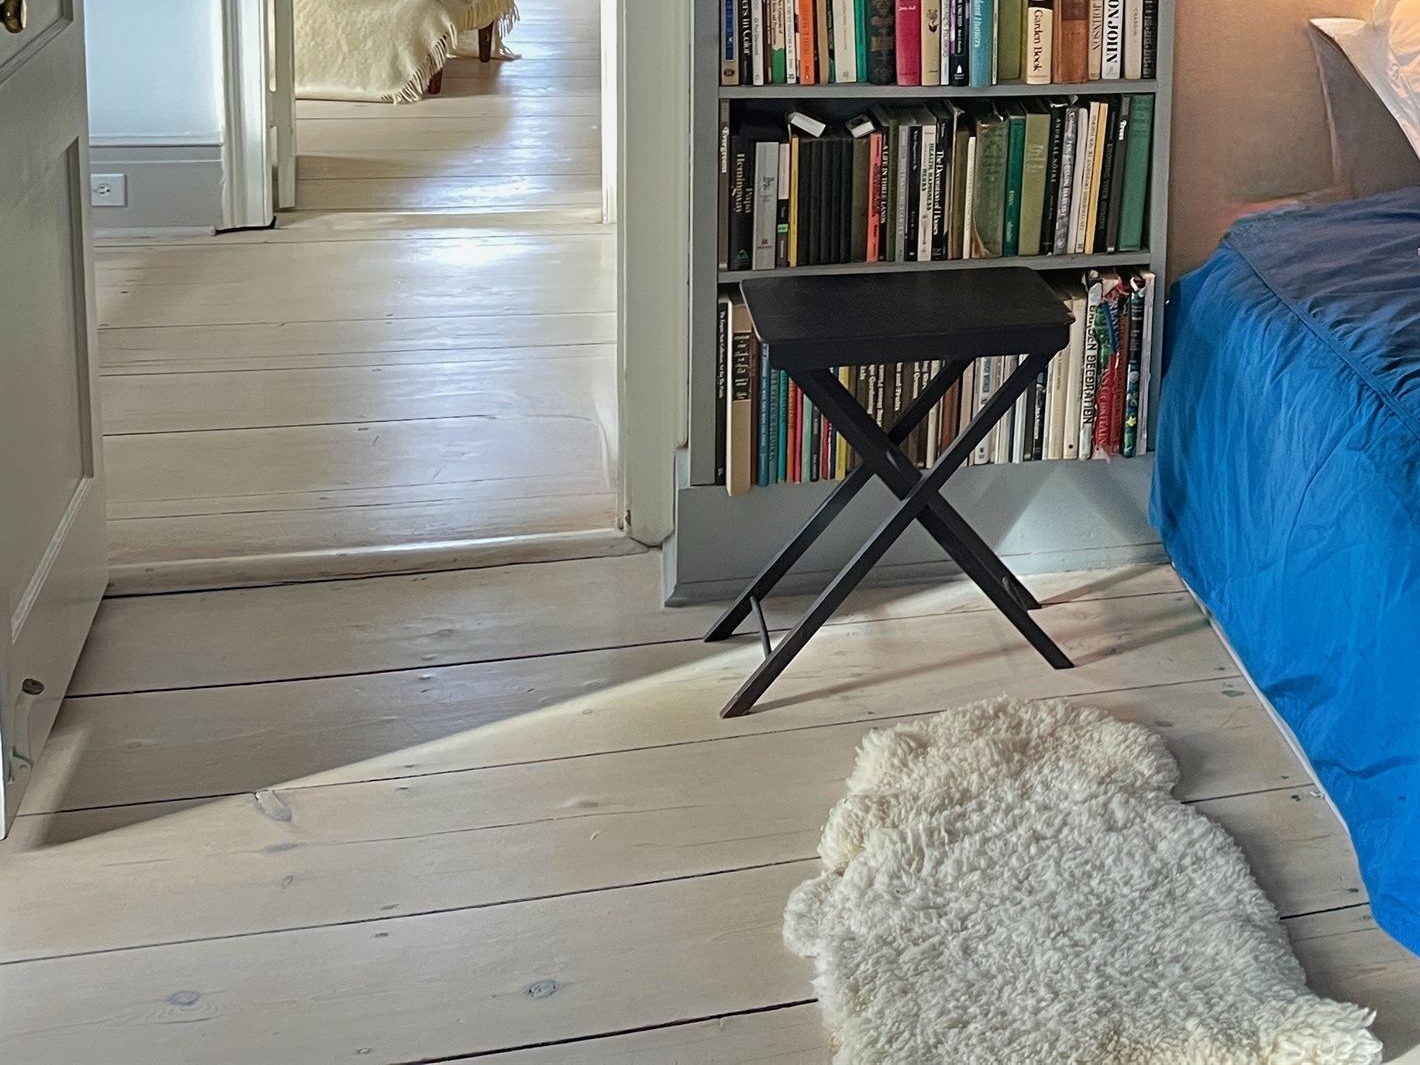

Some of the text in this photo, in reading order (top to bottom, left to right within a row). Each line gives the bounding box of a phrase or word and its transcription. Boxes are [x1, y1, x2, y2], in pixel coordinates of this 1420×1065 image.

[742, 19, 751, 29] in
[742, 30, 752, 56] Color
[973, 17, 983, 48] Hunters
[1034, 10, 1044, 44] Garden
[1091, 4, 1102, 51] JOHNSON
[1106, 21, 1120, 63] JOHN
[1033, 46, 1043, 72] Book
[1119, 119, 1127, 141] Trees
[720, 126, 730, 174] Evergreens
[732, 154, 746, 213] Hemingway
[744, 188, 754, 213] Papa
[933, 150, 945, 235] The Decoration of Houses
[866, 376, 876, 414] Gardening
[1083, 354, 1096, 424] DECORATION
[1098, 402, 1108, 446] BRITAIN
